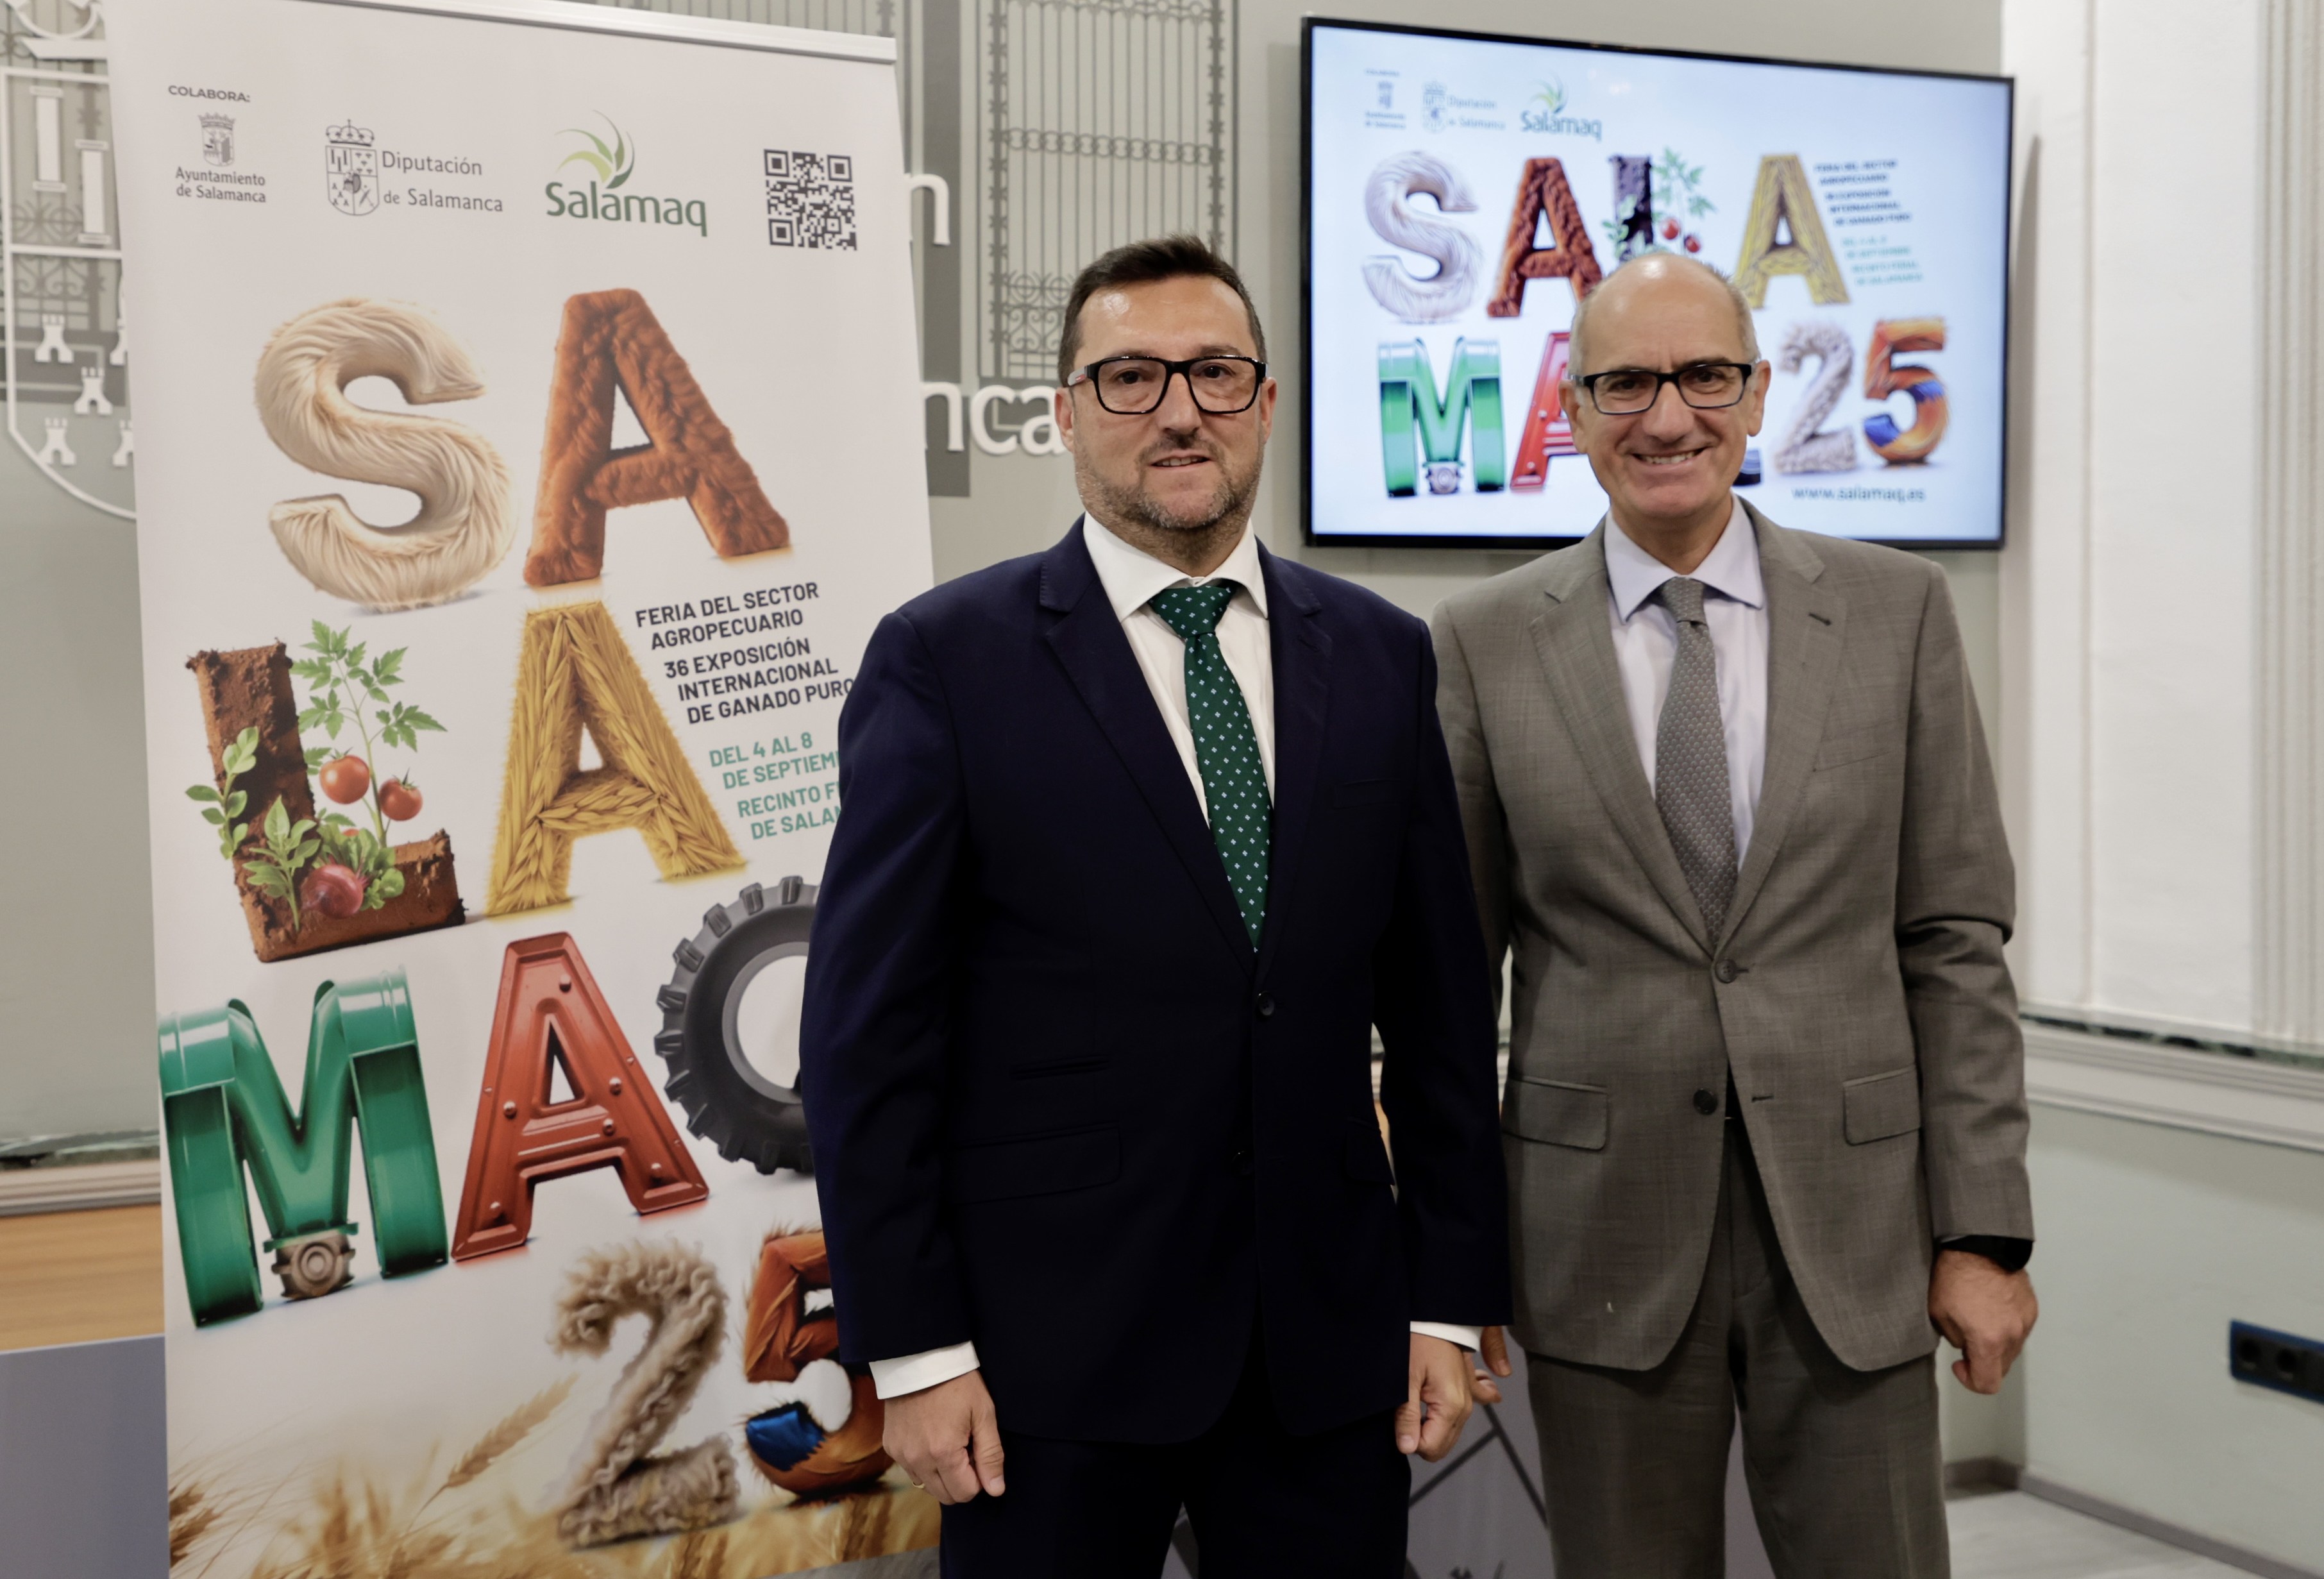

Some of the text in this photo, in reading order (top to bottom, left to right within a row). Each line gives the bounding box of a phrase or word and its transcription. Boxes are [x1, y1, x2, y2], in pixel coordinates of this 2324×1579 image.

[168, 85, 251, 103] COLABORA:
[1520, 110, 1603, 142] Salamaq
[175, 166, 266, 187] Ayuntamiento
[382, 151, 483, 176] Diputación
[176, 185, 266, 203] de Salamanca
[383, 189, 503, 212] de Salamanca
[545, 181, 708, 237] Salamaq
[1774, 317, 1951, 473] 25
[636, 582, 820, 627] FERIA DEL SECTOR
[651, 609, 804, 650] AGROPECUARIO
[664, 638, 811, 679] 36 EXPOSICIÓN
[678, 658, 839, 701] INTERNACIONAL
[687, 704, 715, 724] DE
[718, 689, 802, 718] GANADO
[709, 732, 813, 767] DEL 4 AL 8
[722, 750, 839, 790] DE SEPTIEM
[737, 786, 821, 818] RECINTO
[751, 820, 777, 840] DE
